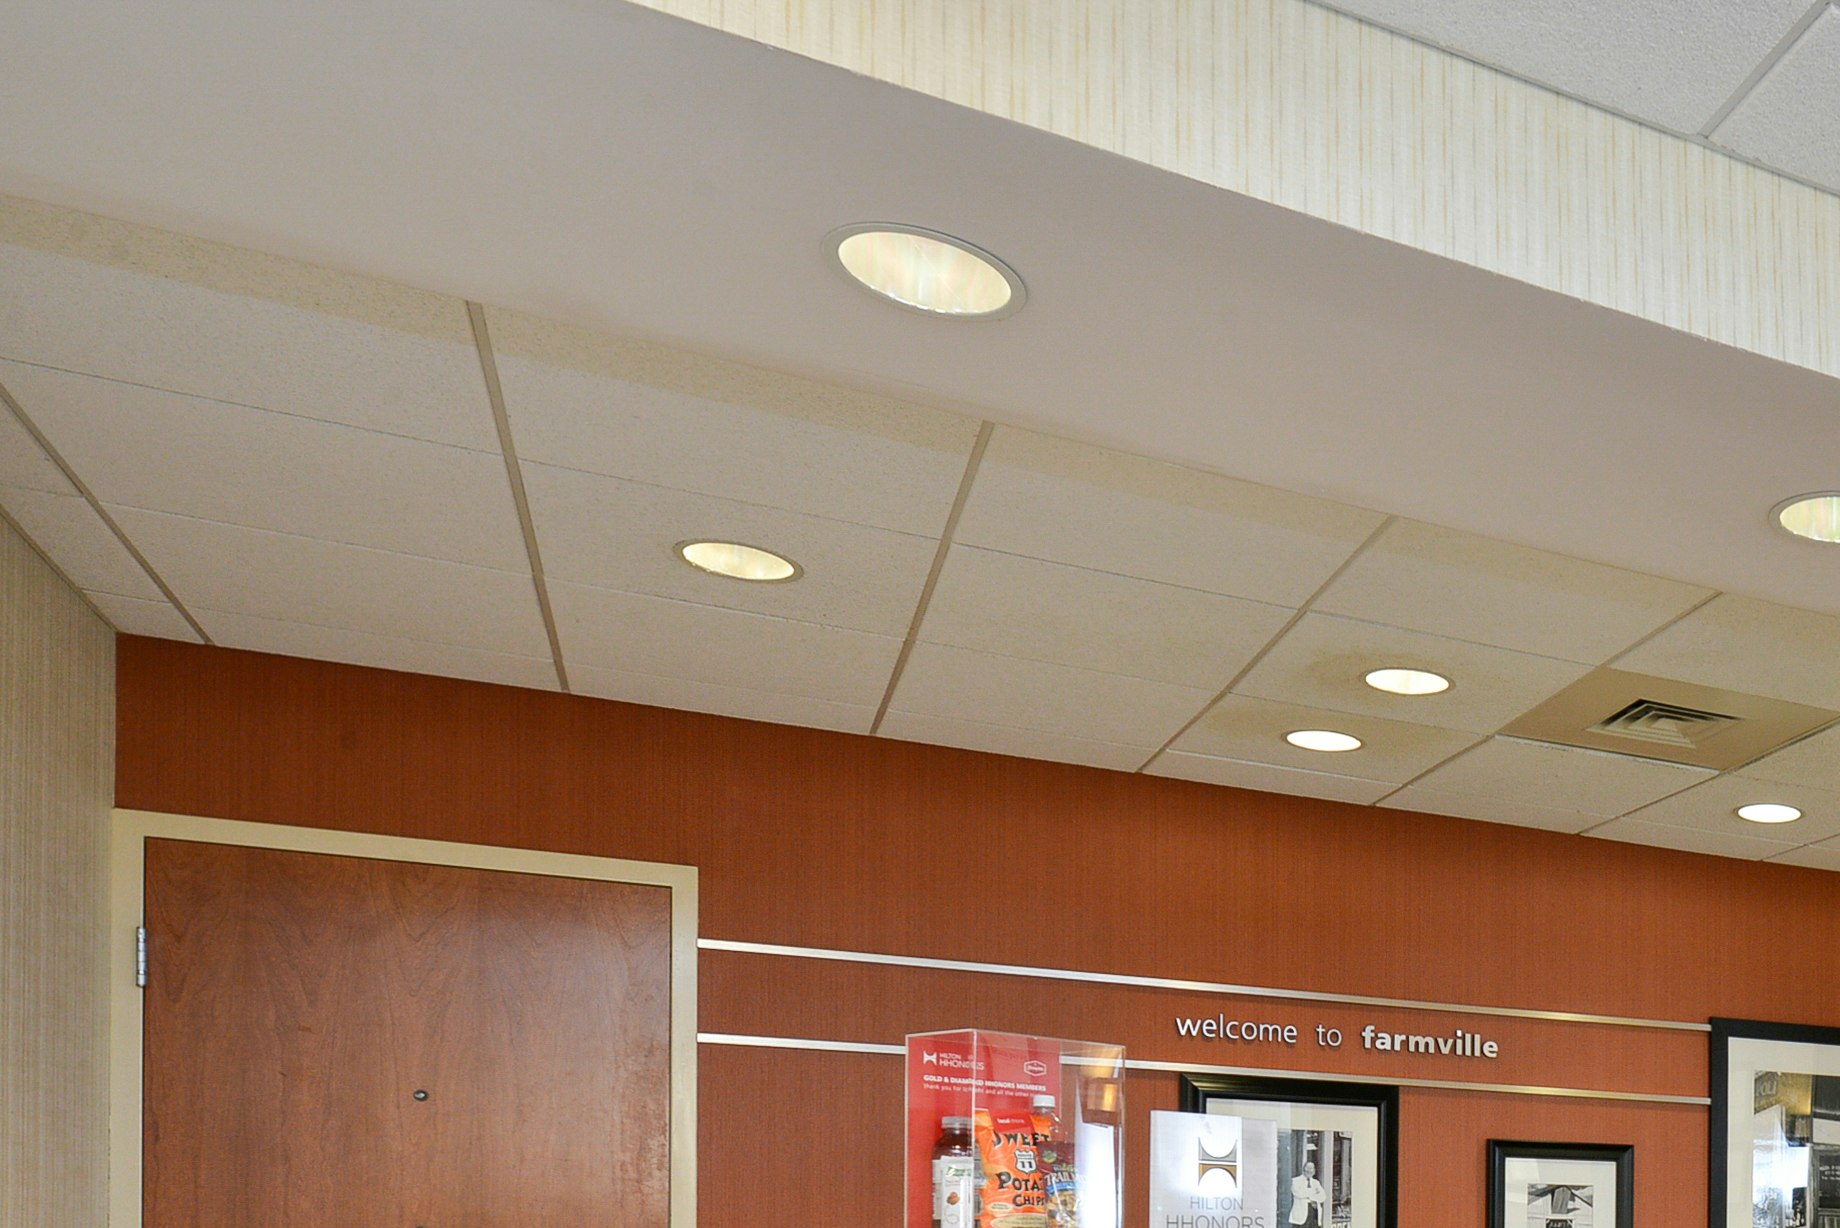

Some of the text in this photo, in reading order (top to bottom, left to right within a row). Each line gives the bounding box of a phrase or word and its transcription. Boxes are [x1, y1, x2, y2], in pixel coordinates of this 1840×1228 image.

[1175, 1013, 1499, 1058] welcome to farmville
[923, 1074, 945, 1083] GOLD
[1016, 1082, 1047, 1092] MEMBERS
[1189, 1195, 1244, 1212] HILTON
